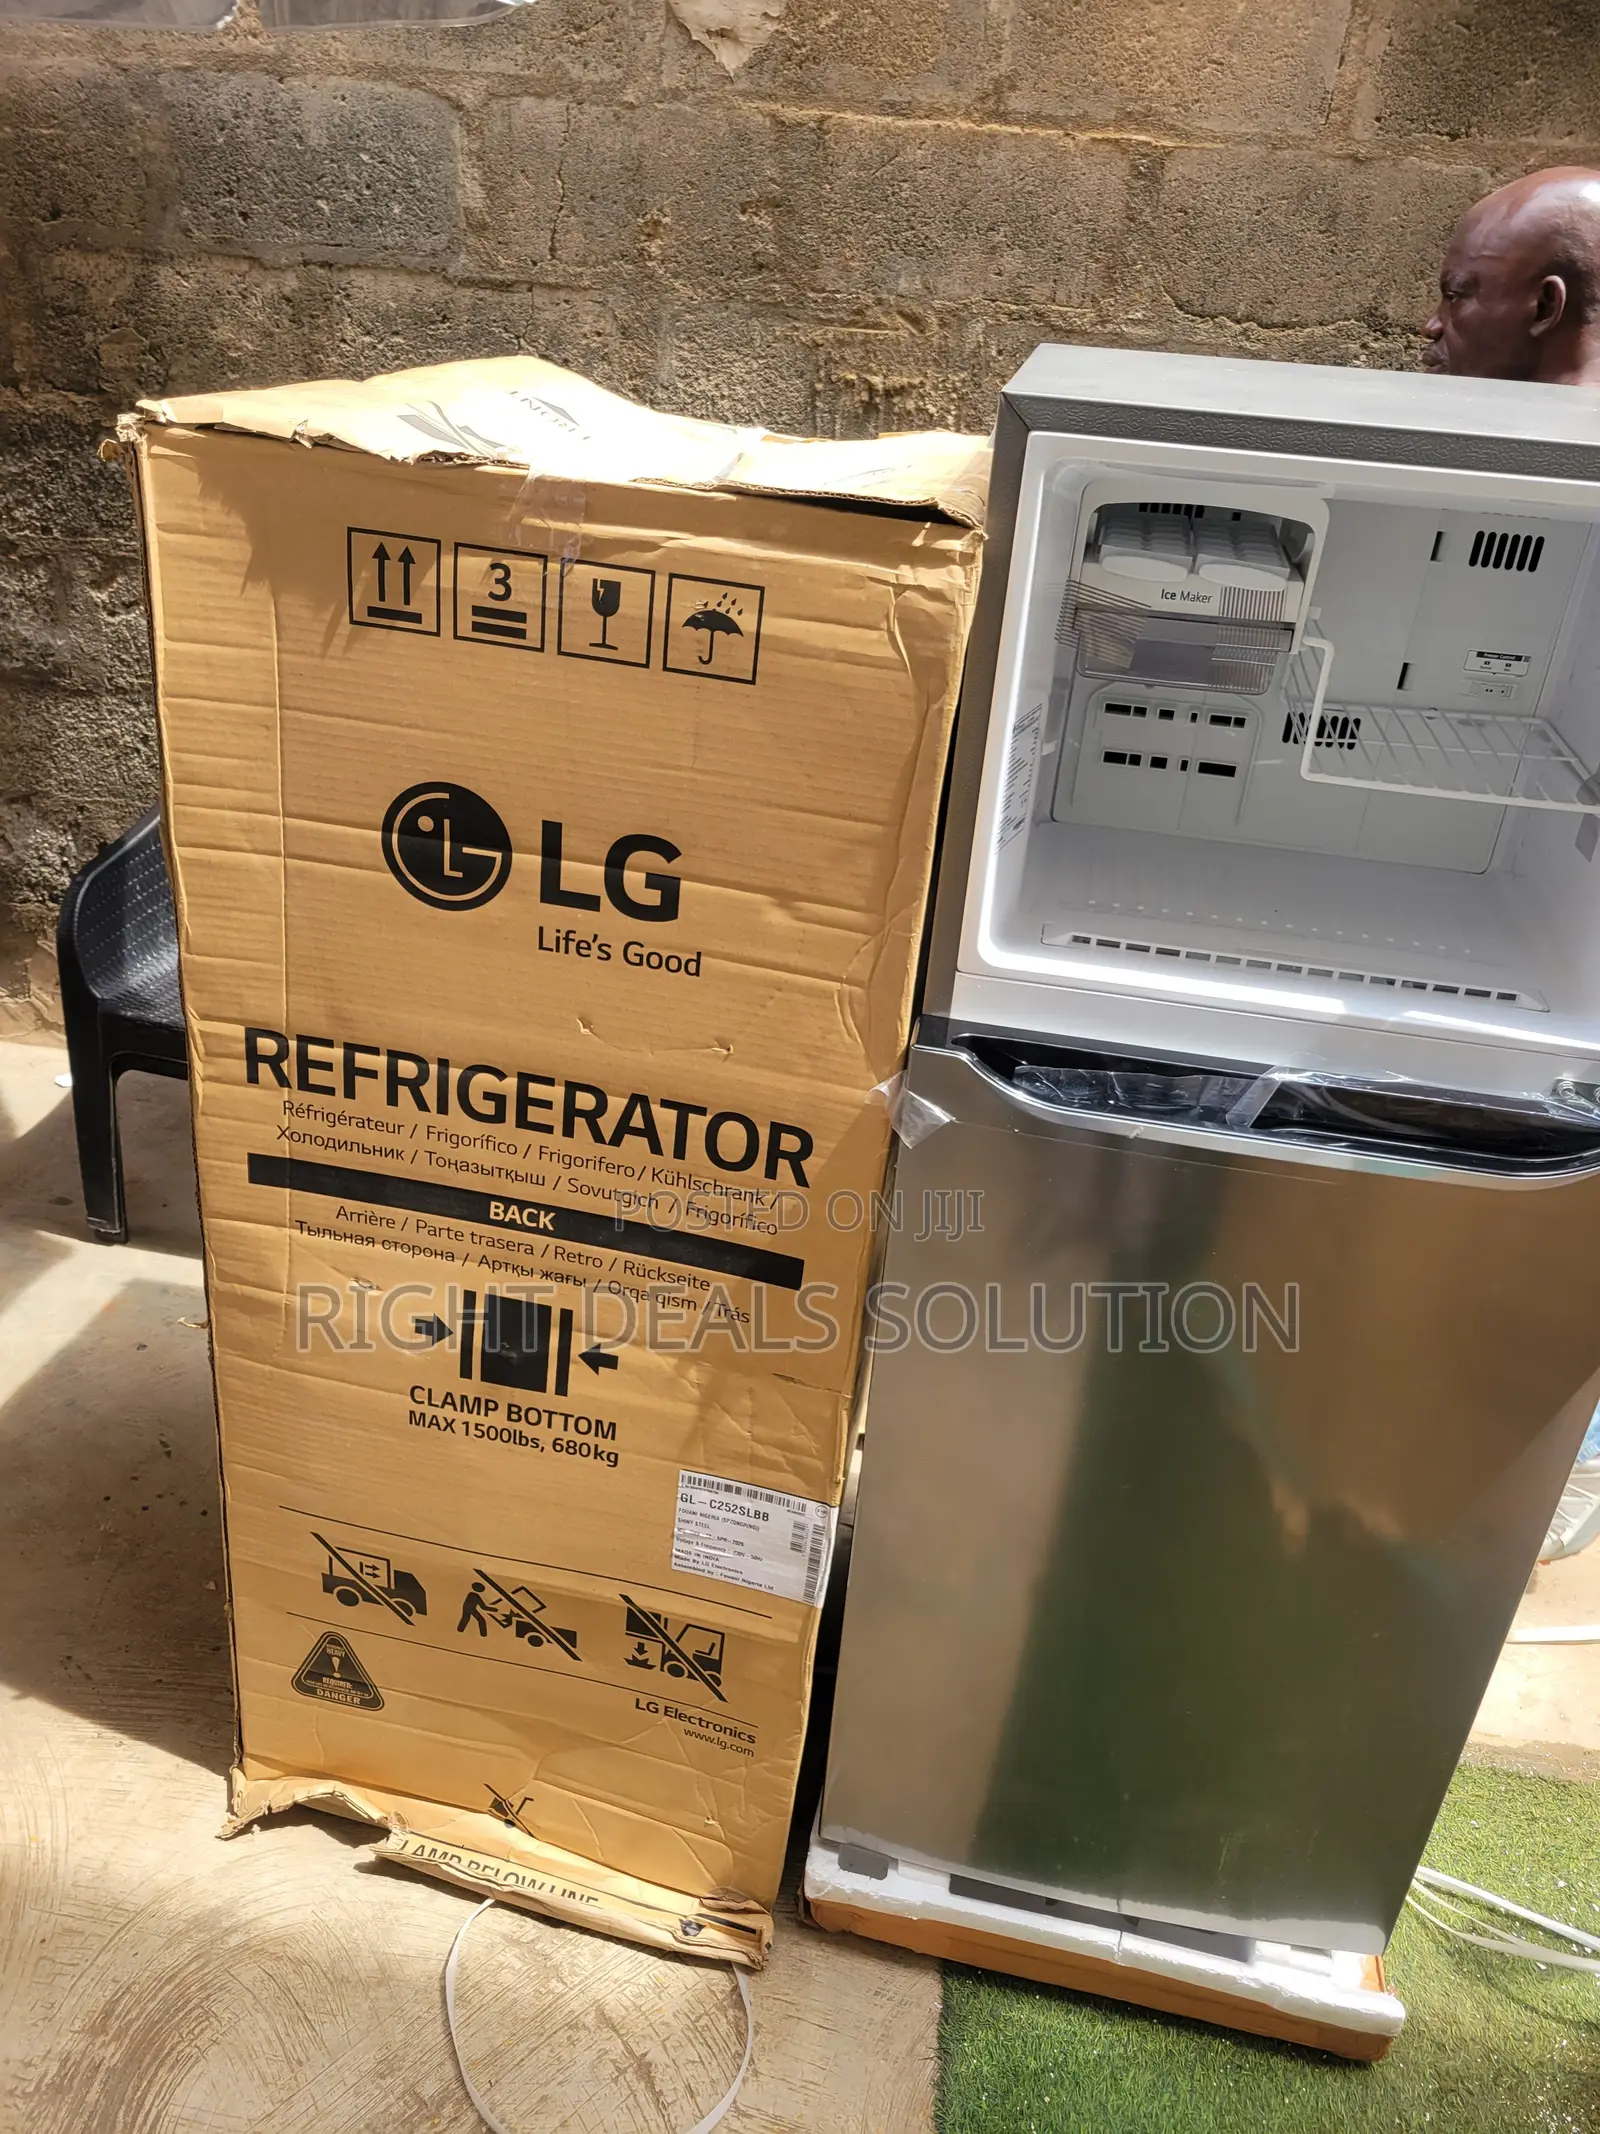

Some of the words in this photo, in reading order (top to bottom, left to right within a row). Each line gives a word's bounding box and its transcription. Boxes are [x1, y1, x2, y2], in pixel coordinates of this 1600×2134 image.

[488, 562, 512, 602] 3
[1161, 588, 1176, 600] Ice
[1180, 590, 1213, 603] Maker
[540, 819, 683, 922] LG
[622, 940, 701, 977] Good
[244, 1027, 814, 1188] REFRIGERATOR
[276, 1125, 405, 1161] Холодильник
[568, 1177, 659, 1211] Sovutgich
[685, 1200, 778, 1236] Frigorífico
[283, 1100, 405, 1135] Réfrigérateur
[426, 1124, 518, 1156] Frigorífico
[538, 1145, 635, 1178] Frigorifero
[651, 1167, 766, 1206] Kühlschrank
[489, 1201, 555, 1232] BACK
[295, 1219, 375, 1248] Тыльная
[381, 1239, 455, 1263] сторона
[608, 1280, 650, 1303] Orqa
[655, 1292, 697, 1312] qism
[714, 1302, 750, 1324] Trás
[336, 1206, 396, 1229] Arrière
[416, 1219, 465, 1242] Parte
[469, 1231, 534, 1255] trasera
[554, 1246, 603, 1268] Retro
[623, 1260, 710, 1291] Rückseite
[408, 1410, 456, 1434] MAX
[461, 1420, 546, 1454] 1500lbs,
[551, 1437, 620, 1468] 680kg
[409, 1384, 499, 1418] CLAMP
[506, 1402, 617, 1441] BOTTOM
[316, 1688, 361, 1705] DANGER
[635, 1698, 659, 1714] LG
[663, 1705, 756, 1744] Electronics
[683, 1728, 755, 1757] www.lg.com
